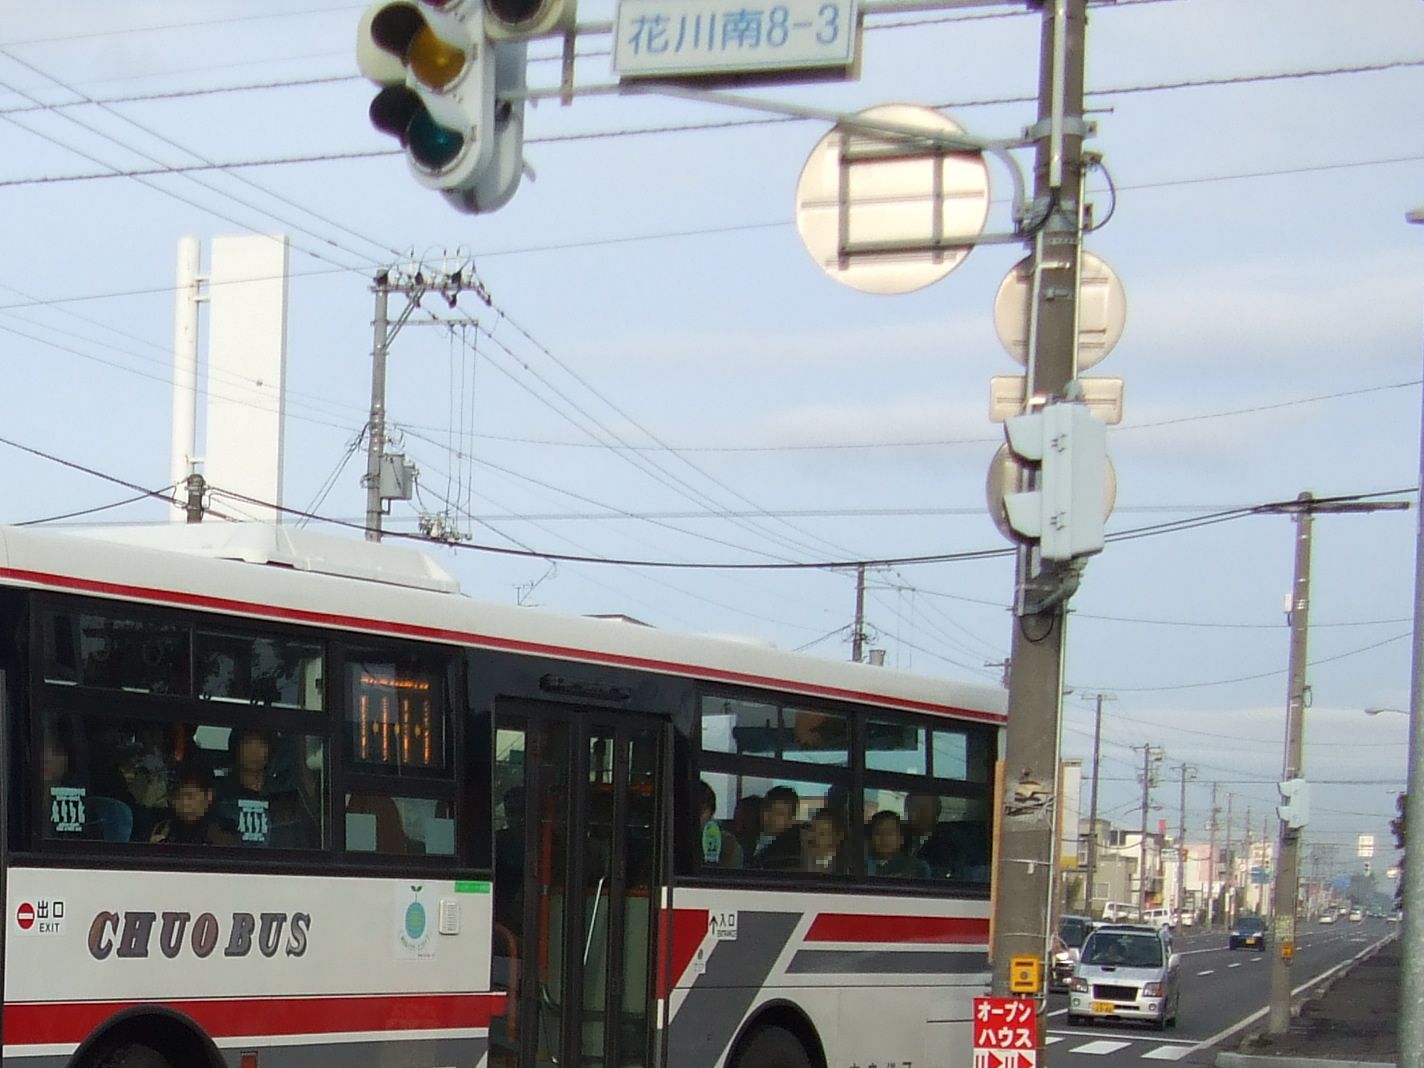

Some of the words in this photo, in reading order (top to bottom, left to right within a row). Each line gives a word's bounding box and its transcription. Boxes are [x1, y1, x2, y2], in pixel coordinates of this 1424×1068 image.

[628, 3, 840, 54] 花川南8-3
[37, 900, 64, 919] 出口
[718, 913, 735, 927] 入口
[39, 922, 61, 933] EXIT
[87, 910, 220, 960] CHUO
[223, 911, 312, 958] BUS
[977, 1000, 1032, 1023] オープン
[978, 1026, 1033, 1048] ハウス
